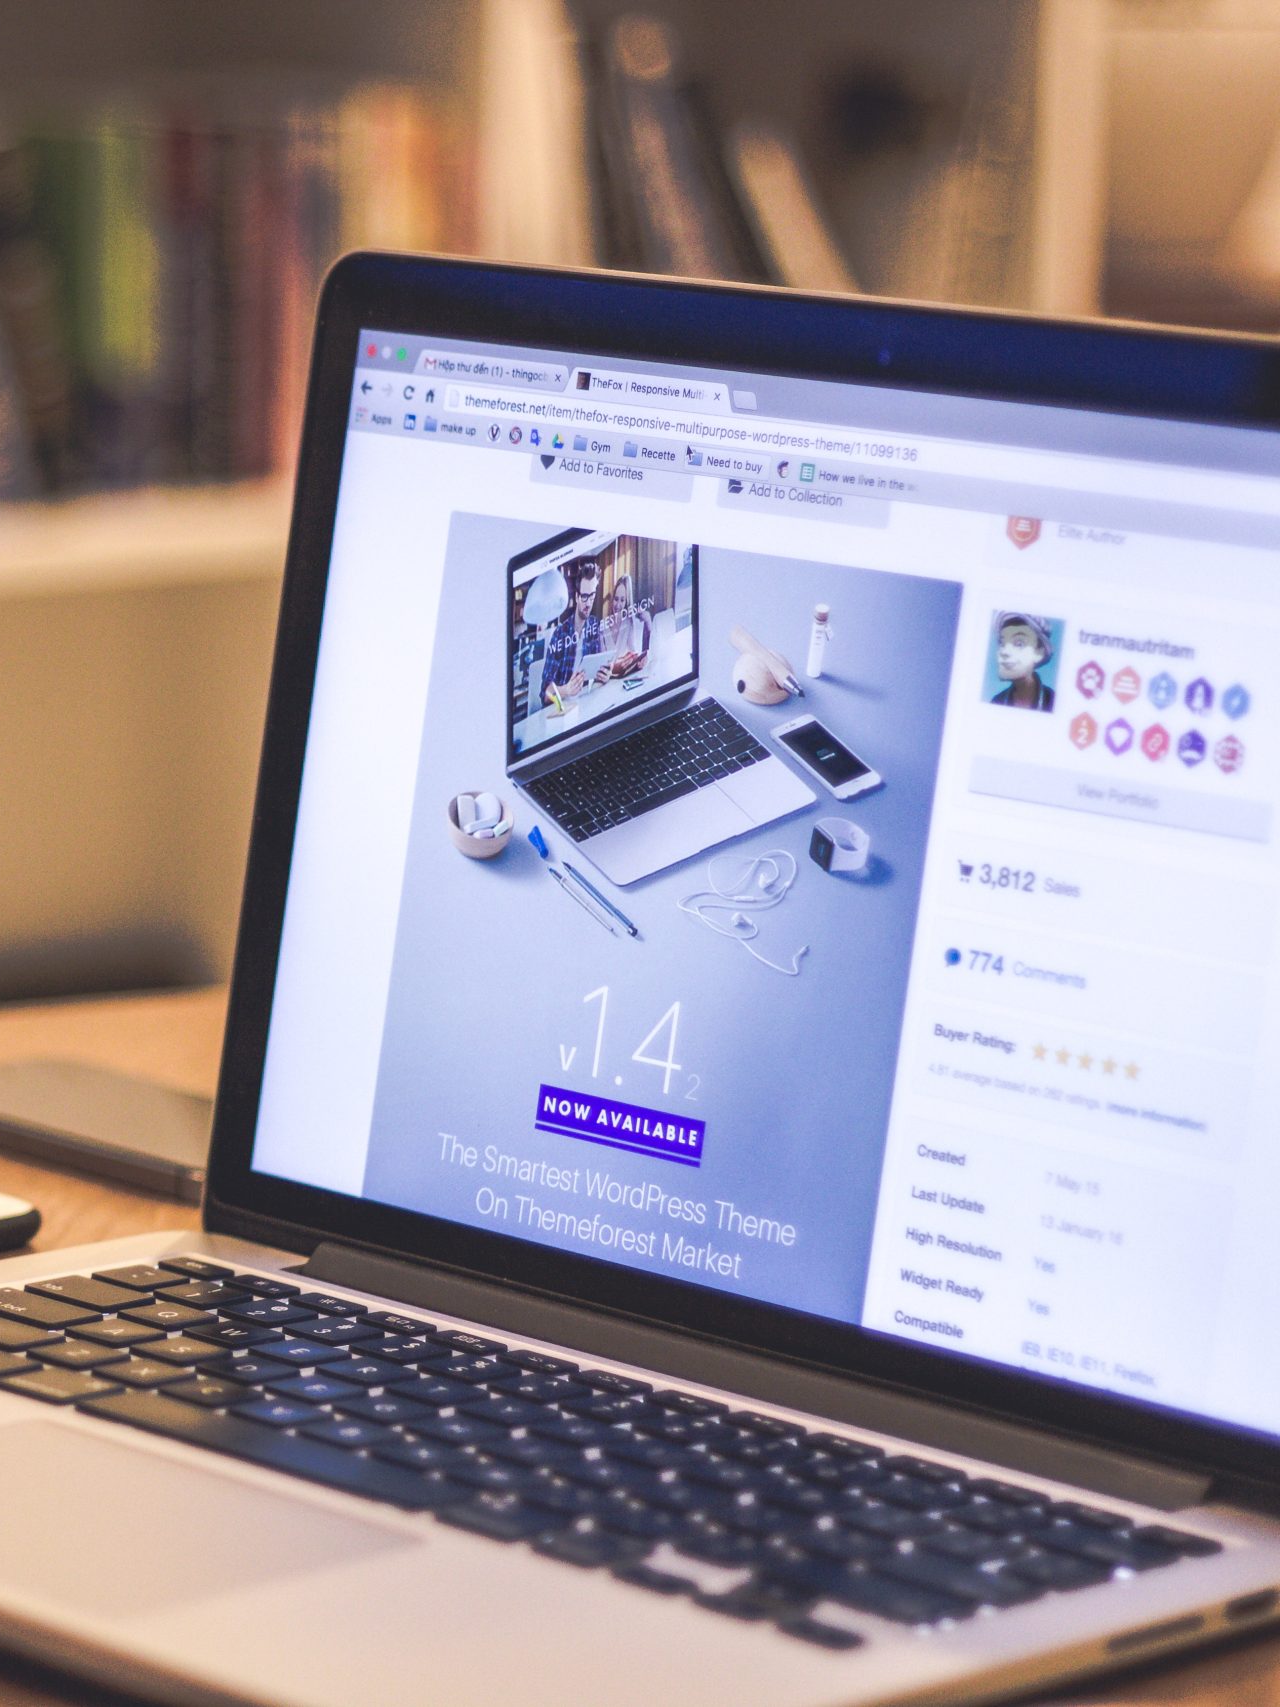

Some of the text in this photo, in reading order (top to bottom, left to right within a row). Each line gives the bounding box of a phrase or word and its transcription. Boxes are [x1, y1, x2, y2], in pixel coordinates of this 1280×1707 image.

[491, 366, 503, 379] (1)
[592, 377, 623, 391] TheFox
[630, 382, 680, 398] Responsive
[371, 414, 392, 426] Apps
[441, 423, 476, 436] make up
[591, 441, 611, 453] Gym
[641, 447, 676, 461] Recette
[559, 458, 644, 481] Add to Favorites
[706, 456, 763, 474] Need to buy
[819, 470, 840, 482] How
[842, 474, 856, 485] we
[858, 474, 875, 487] live
[877, 477, 886, 488] in
[889, 479, 905, 491] the
[748, 483, 843, 507] Add to Collection
[565, 632, 578, 648] DO
[581, 623, 597, 638] THE
[600, 611, 618, 631] BEST
[620, 597, 655, 621] DESIGN
[979, 863, 1081, 898] 3,812 Sales
[969, 949, 1087, 989] 774 Comments
[934, 1024, 1016, 1054] Buyer Rating:
[544, 1096, 698, 1147] NOW AVAILABLE
[917, 1143, 966, 1167] Created
[438, 1132, 796, 1247] The Smartest WordPress Theme
[912, 1185, 985, 1214] Last Update
[476, 1187, 742, 1279] On Themeforest Market
[906, 1227, 1003, 1262] High Resolution
[900, 1267, 984, 1303] Widget Ready
[894, 1309, 964, 1339] Compatible
